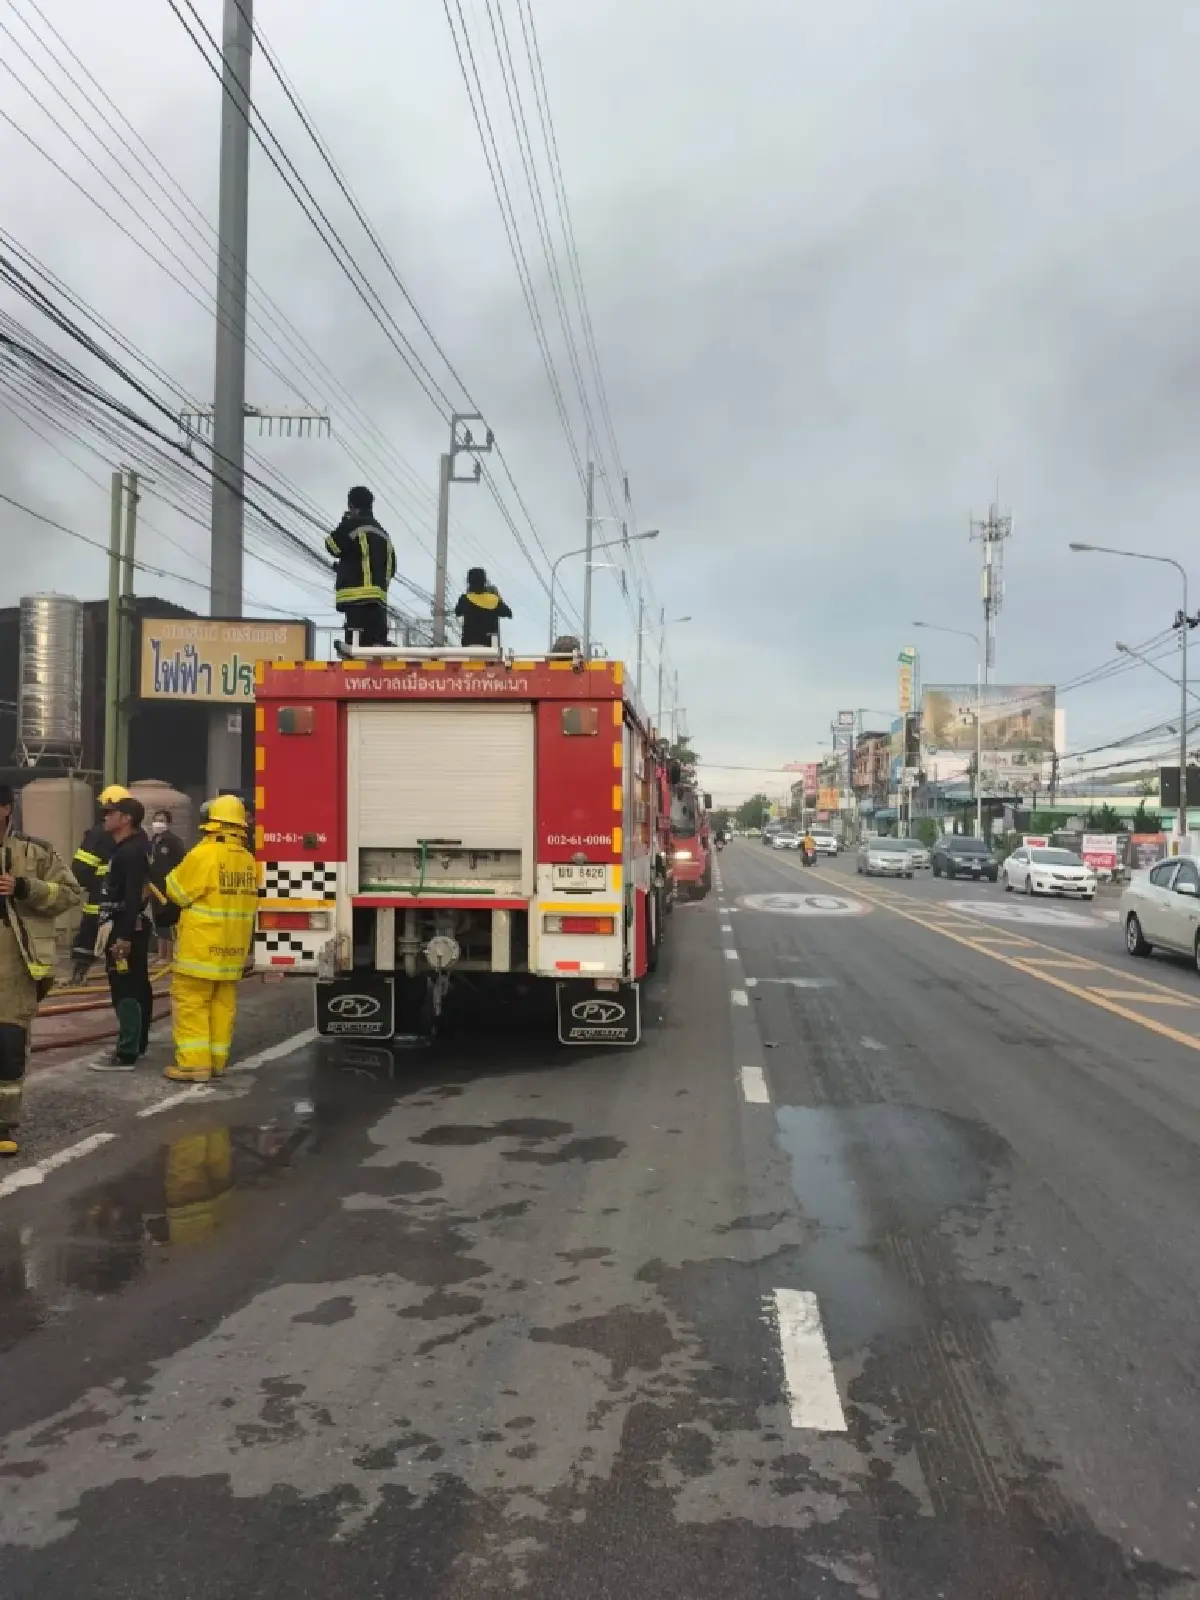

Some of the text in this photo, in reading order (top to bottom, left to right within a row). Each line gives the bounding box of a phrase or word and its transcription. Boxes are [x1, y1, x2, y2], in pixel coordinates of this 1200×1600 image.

[150, 639, 212, 695] ไฟฟ้า
[344, 672, 528, 691] เทศบาลเมืองบางรักพัฒนา
